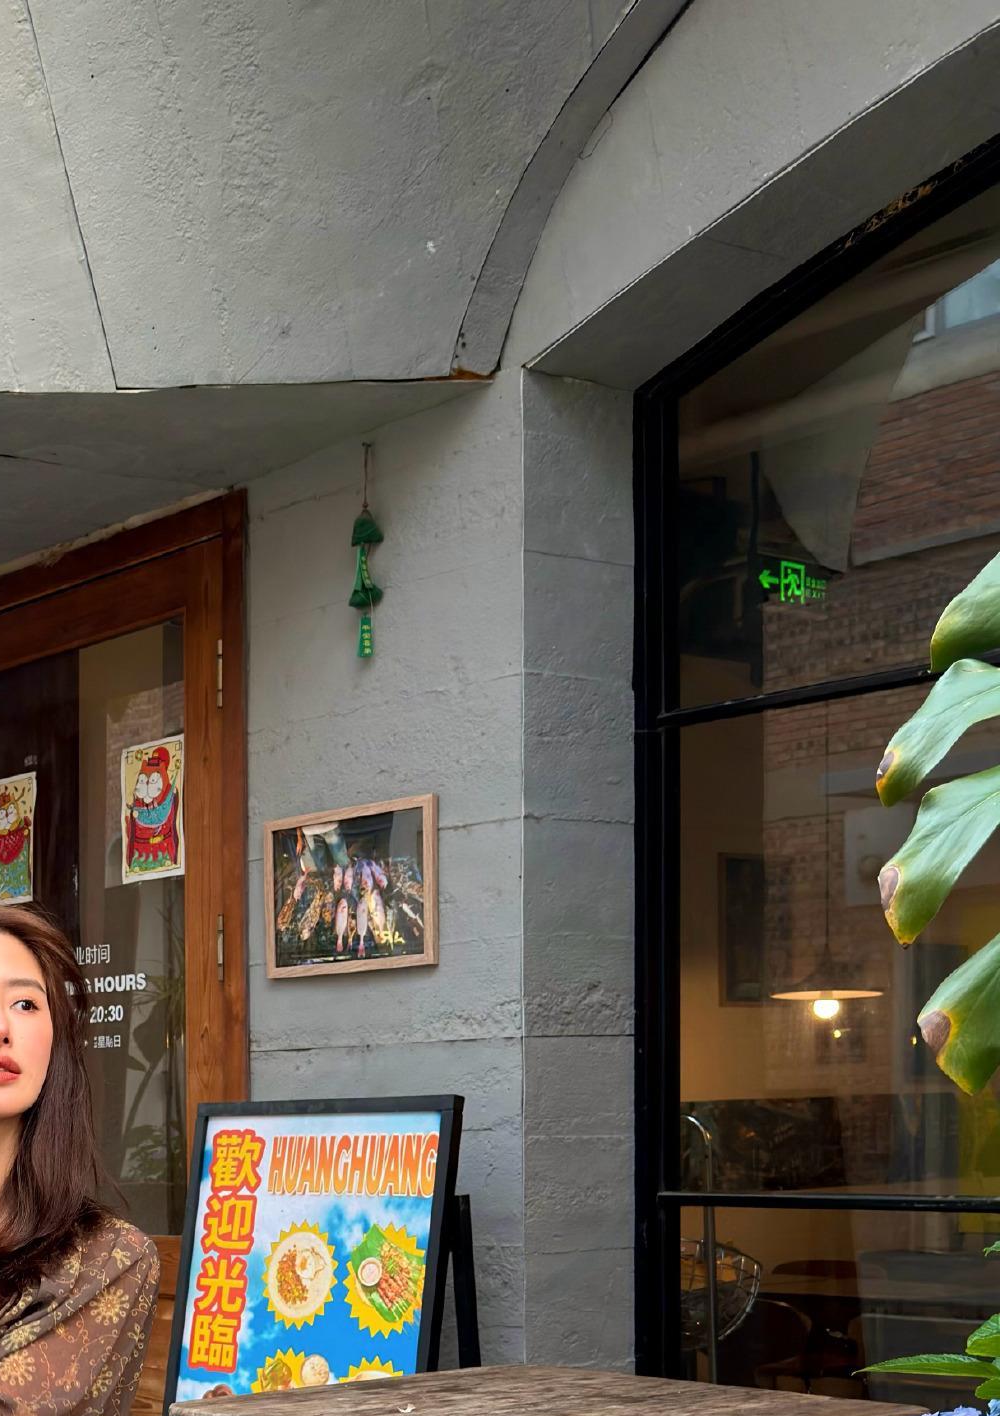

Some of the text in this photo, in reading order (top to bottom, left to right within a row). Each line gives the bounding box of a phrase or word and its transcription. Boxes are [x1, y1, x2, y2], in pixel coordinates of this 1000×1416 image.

[75, 944, 111, 965] 业时间
[94, 973, 147, 993] HOURS
[89, 1004, 124, 1024] 20:30
[267, 1132, 440, 1197] HUANGHUANG
[189, 1130, 264, 1372] 歡迎光臨
